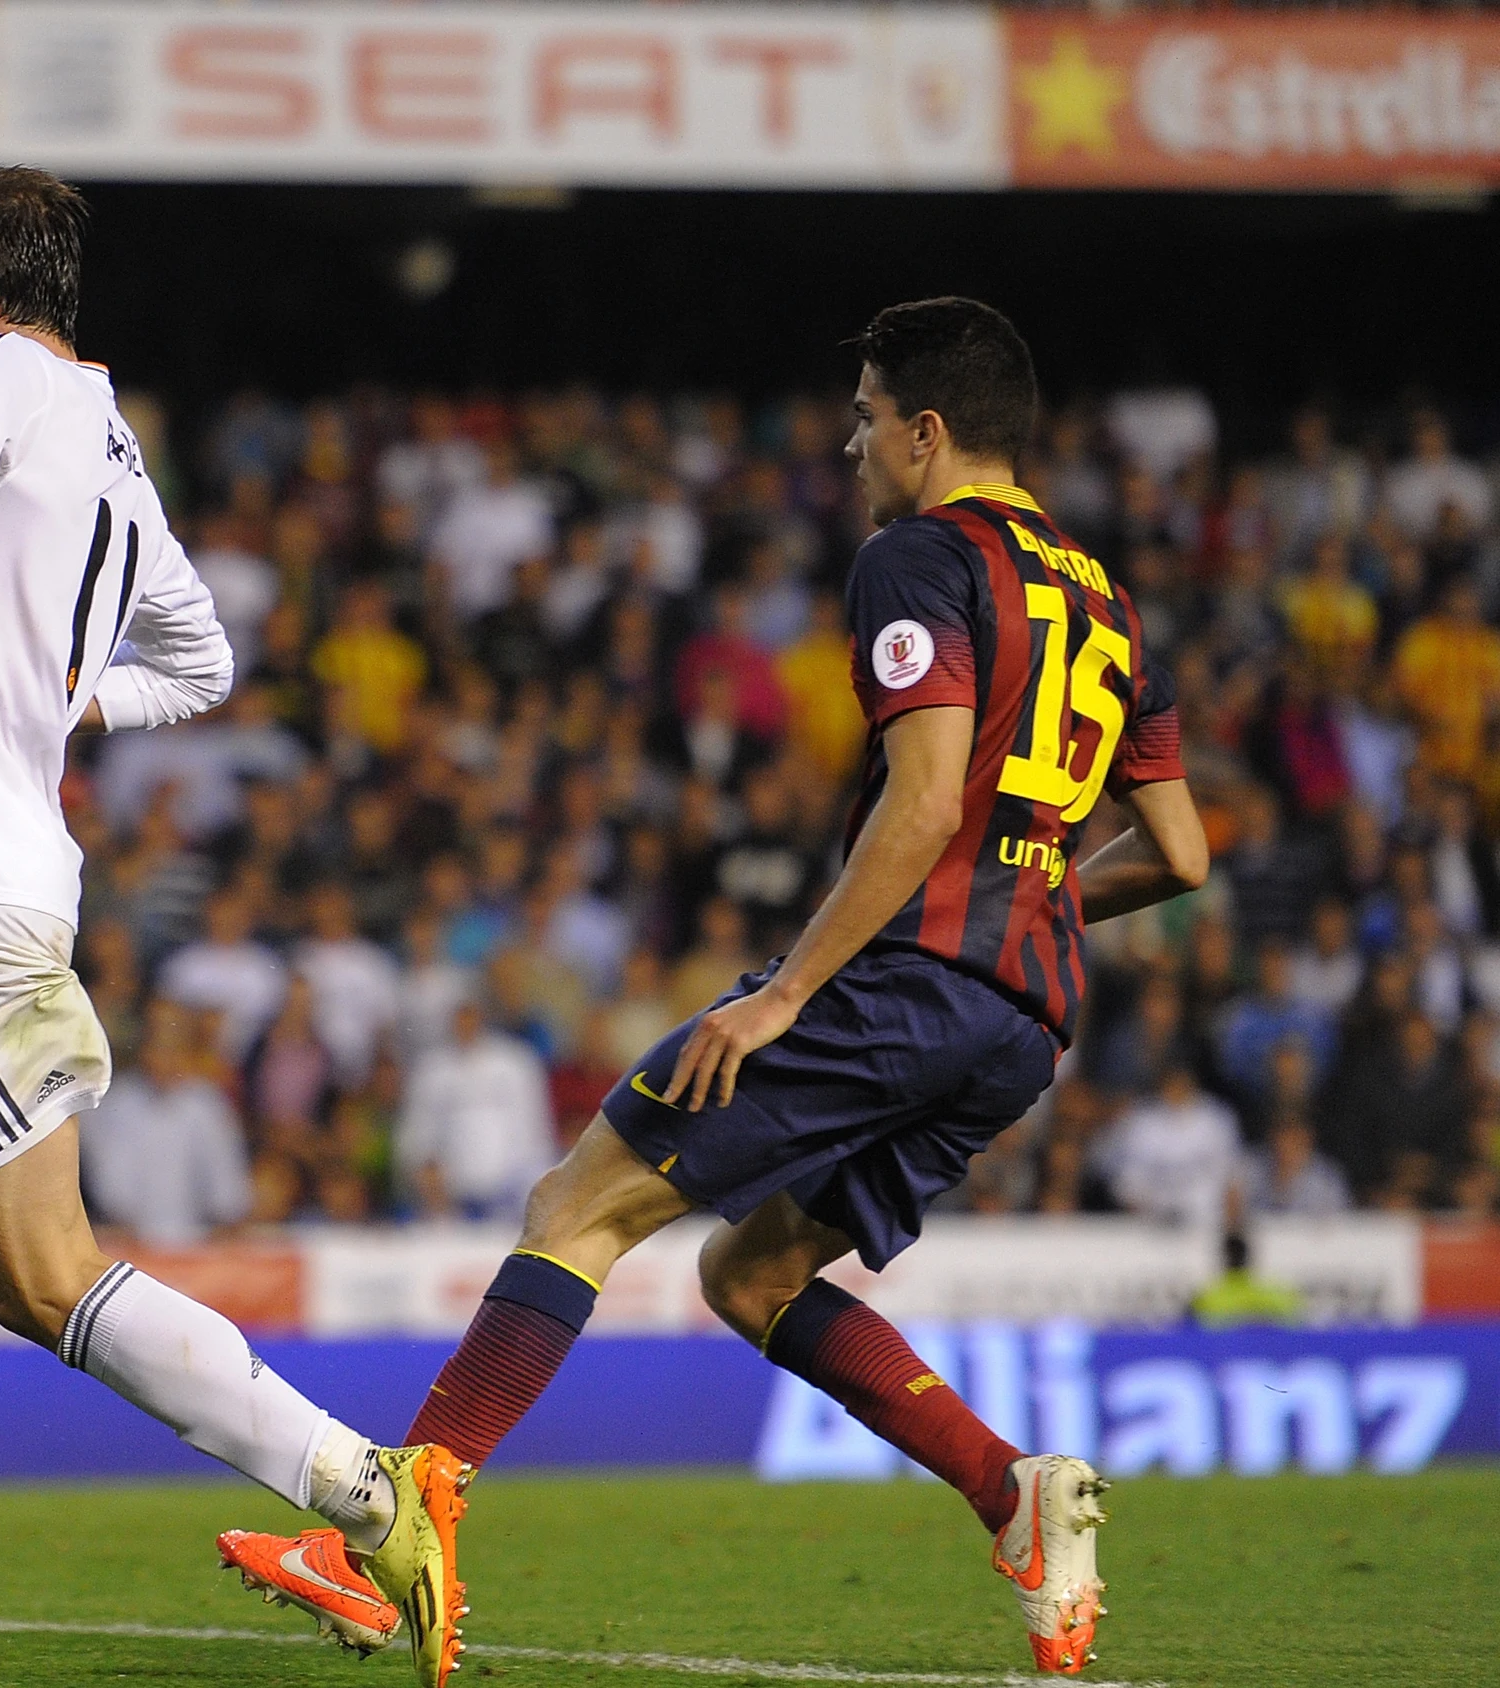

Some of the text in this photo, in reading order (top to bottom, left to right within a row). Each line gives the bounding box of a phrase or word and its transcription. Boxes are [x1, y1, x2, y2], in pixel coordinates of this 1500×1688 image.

[156, 22, 856, 152] SEAT
[996, 583, 1132, 823] 15
[37, 1074, 76, 1104] adidas
